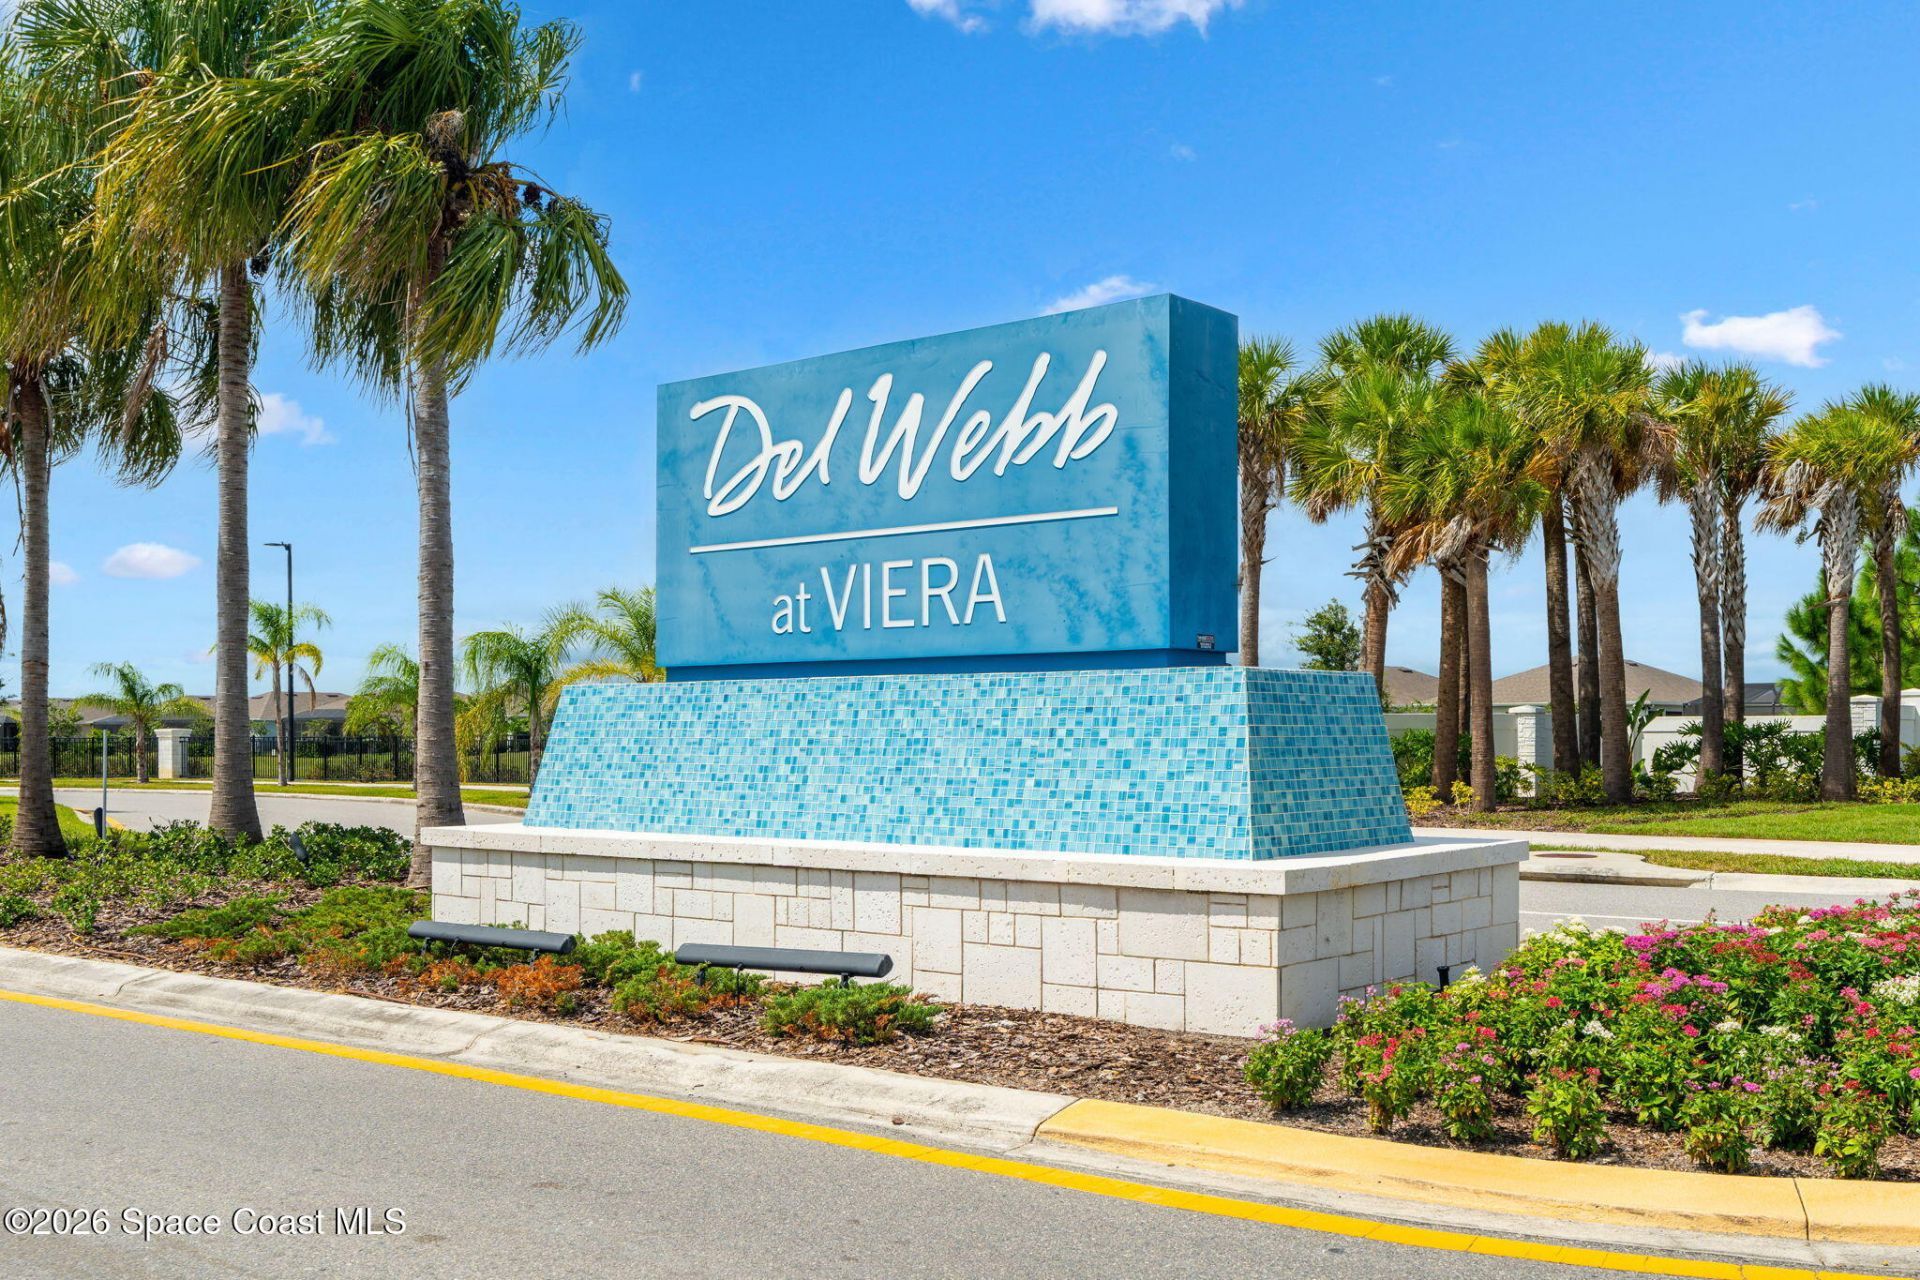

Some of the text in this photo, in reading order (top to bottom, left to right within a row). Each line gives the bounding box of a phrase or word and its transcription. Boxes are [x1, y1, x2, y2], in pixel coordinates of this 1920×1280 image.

[690, 349, 1119, 516] Del Webb
[771, 553, 1007, 635] at VIERA
